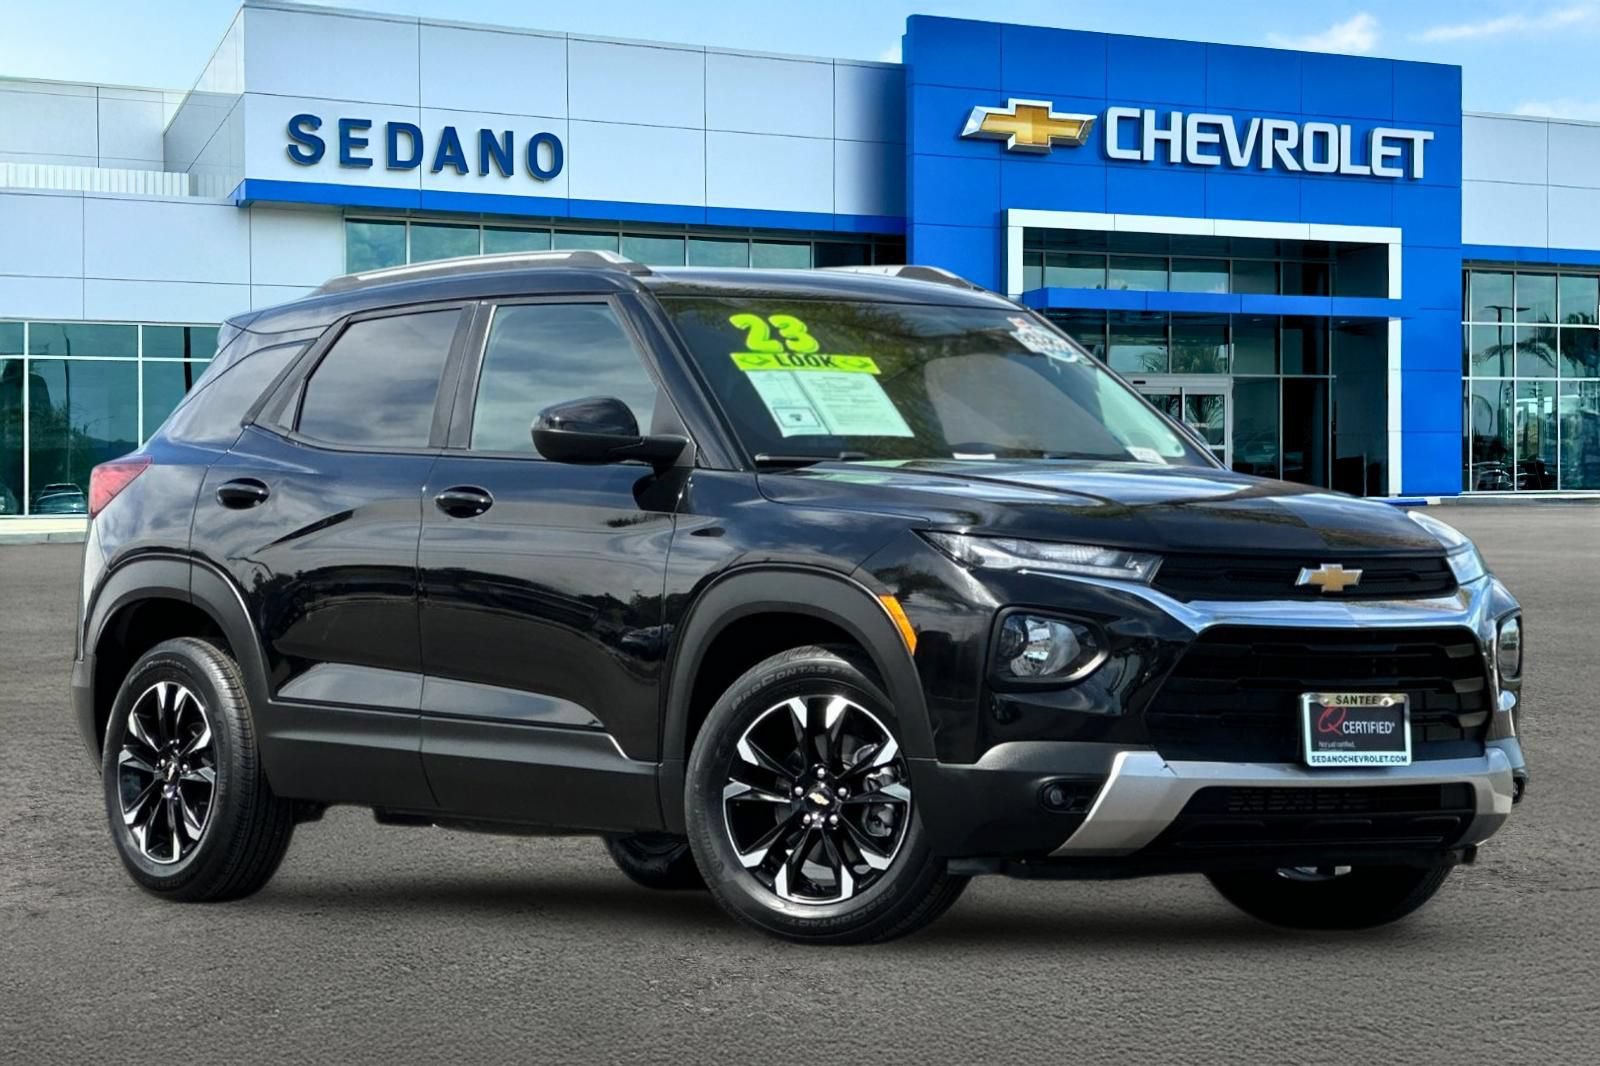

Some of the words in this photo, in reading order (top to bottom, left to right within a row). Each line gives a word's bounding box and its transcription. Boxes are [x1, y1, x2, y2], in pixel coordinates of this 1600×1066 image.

[287, 113, 564, 182] SEDANO
[1105, 105, 1435, 179] CHEVROLET
[729, 313, 820, 353] 23
[773, 353, 838, 368] LOOK
[1335, 695, 1378, 705] SANTEE
[1311, 755, 1408, 764] SEDANOCHEVROLET.COM
